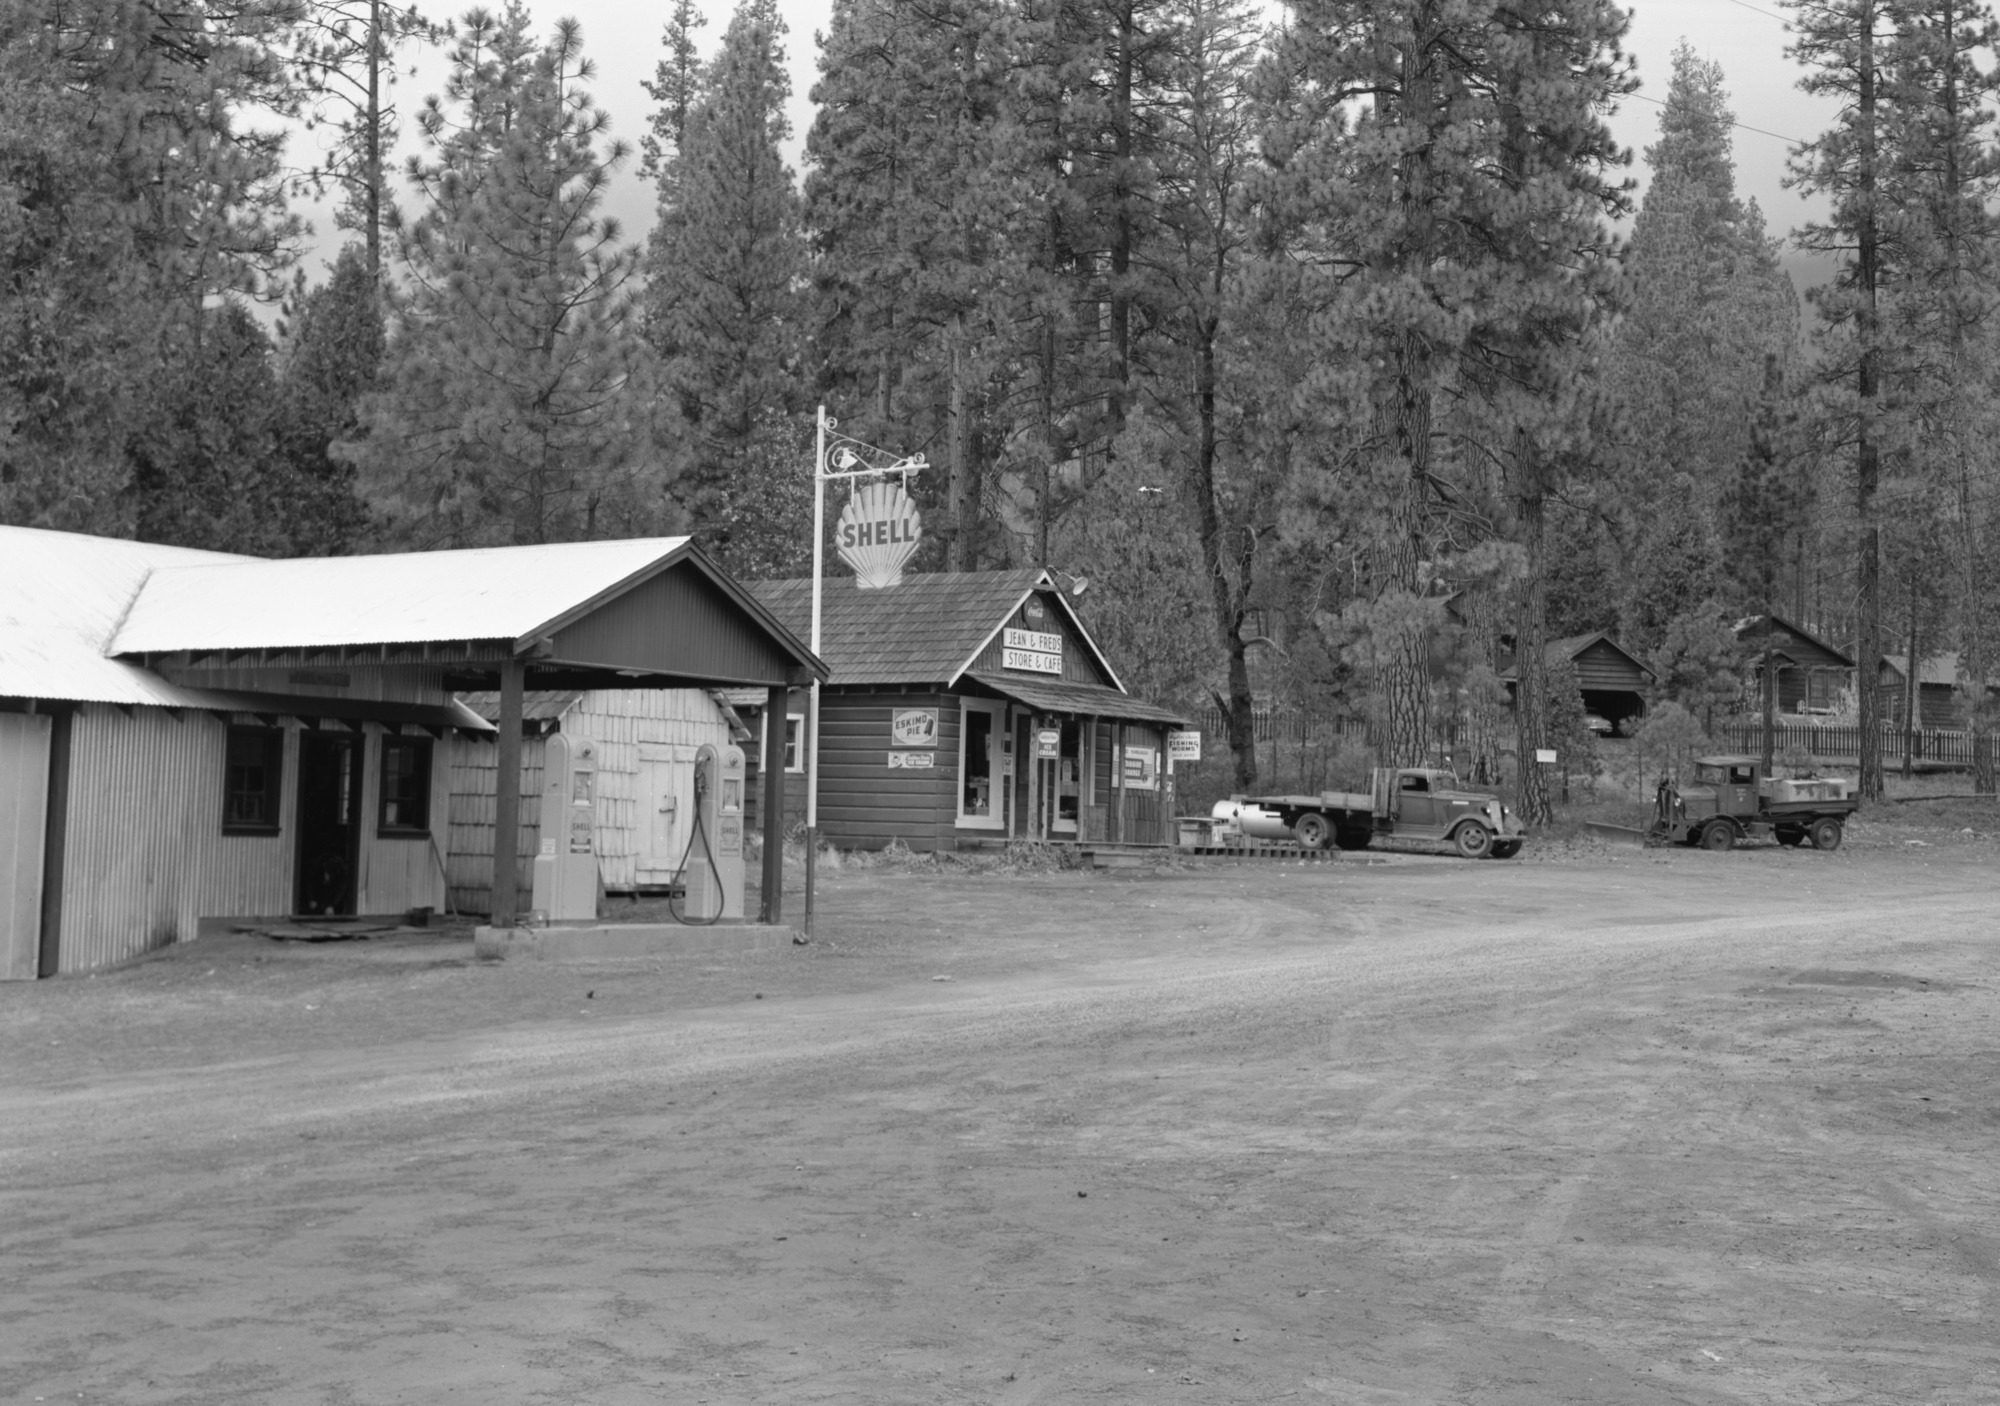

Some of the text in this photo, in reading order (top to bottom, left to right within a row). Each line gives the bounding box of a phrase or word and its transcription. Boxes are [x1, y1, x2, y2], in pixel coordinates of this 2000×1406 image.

[843, 518, 914, 548] SHELL
[1009, 631, 1061, 651] JEAN & FRED'S
[1008, 651, 1061, 671] STORE & CAFE
[895, 714, 927, 730] ESKIMO
[907, 726, 921, 736] PIE
[1169, 740, 1199, 749] FISHING
[572, 822, 590, 831] SHELL
[721, 826, 739, 835] SHELL
